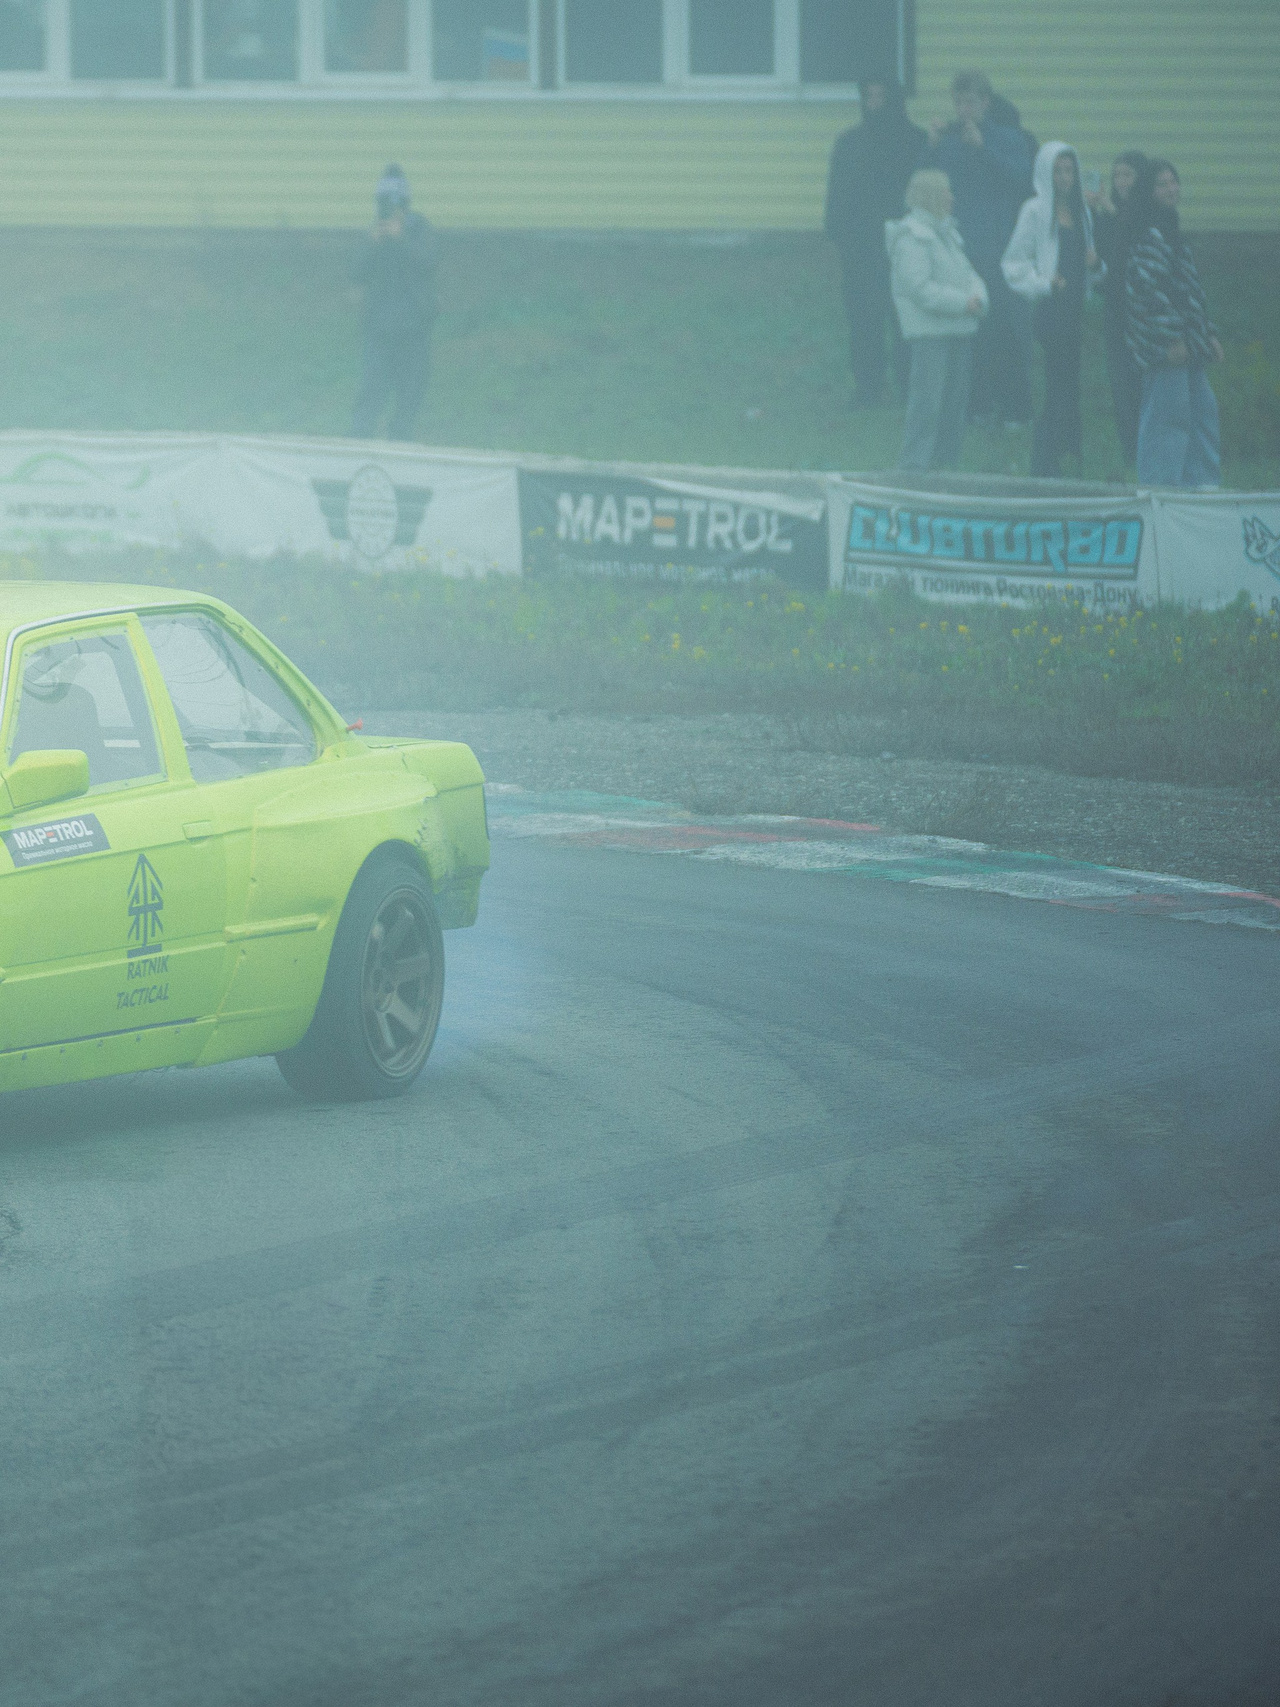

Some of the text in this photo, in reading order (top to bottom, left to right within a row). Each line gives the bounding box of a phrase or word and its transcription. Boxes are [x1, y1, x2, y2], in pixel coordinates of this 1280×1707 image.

[556, 492, 794, 552] MAPETROL
[849, 504, 1141, 573] CLUBTURBO
[13, 819, 94, 849] MAPETROL
[127, 954, 171, 980] RATNIK
[116, 982, 170, 1010] TACTICAL
